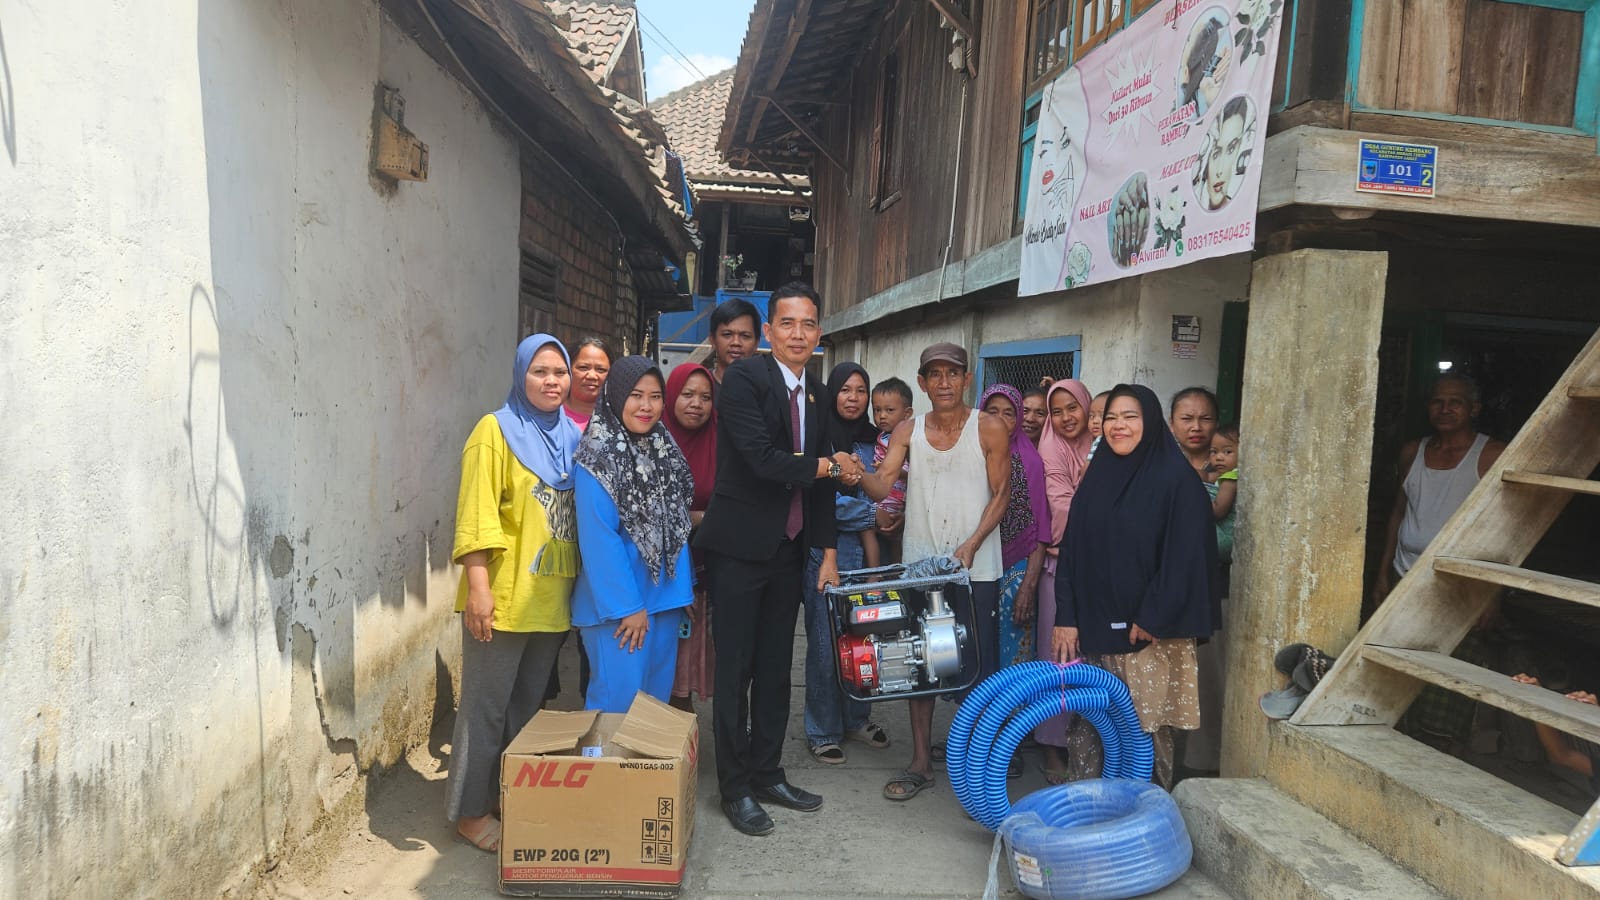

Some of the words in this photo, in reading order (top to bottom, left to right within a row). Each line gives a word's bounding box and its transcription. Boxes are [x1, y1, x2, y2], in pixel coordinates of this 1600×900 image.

[1160, 158, 1186, 180] MAKE
[1184, 153, 1198, 171] UP
[1389, 164, 1412, 177] 101
[1421, 169, 1432, 186] 2
[1079, 204, 1095, 222] NAIL
[1096, 198, 1113, 215] ART
[1138, 245, 1167, 264] Alvirani
[860, 609, 875, 619] NLG
[512, 761, 596, 789] NLG
[513, 848, 547, 862] EWP
[551, 849, 580, 863] 20G
